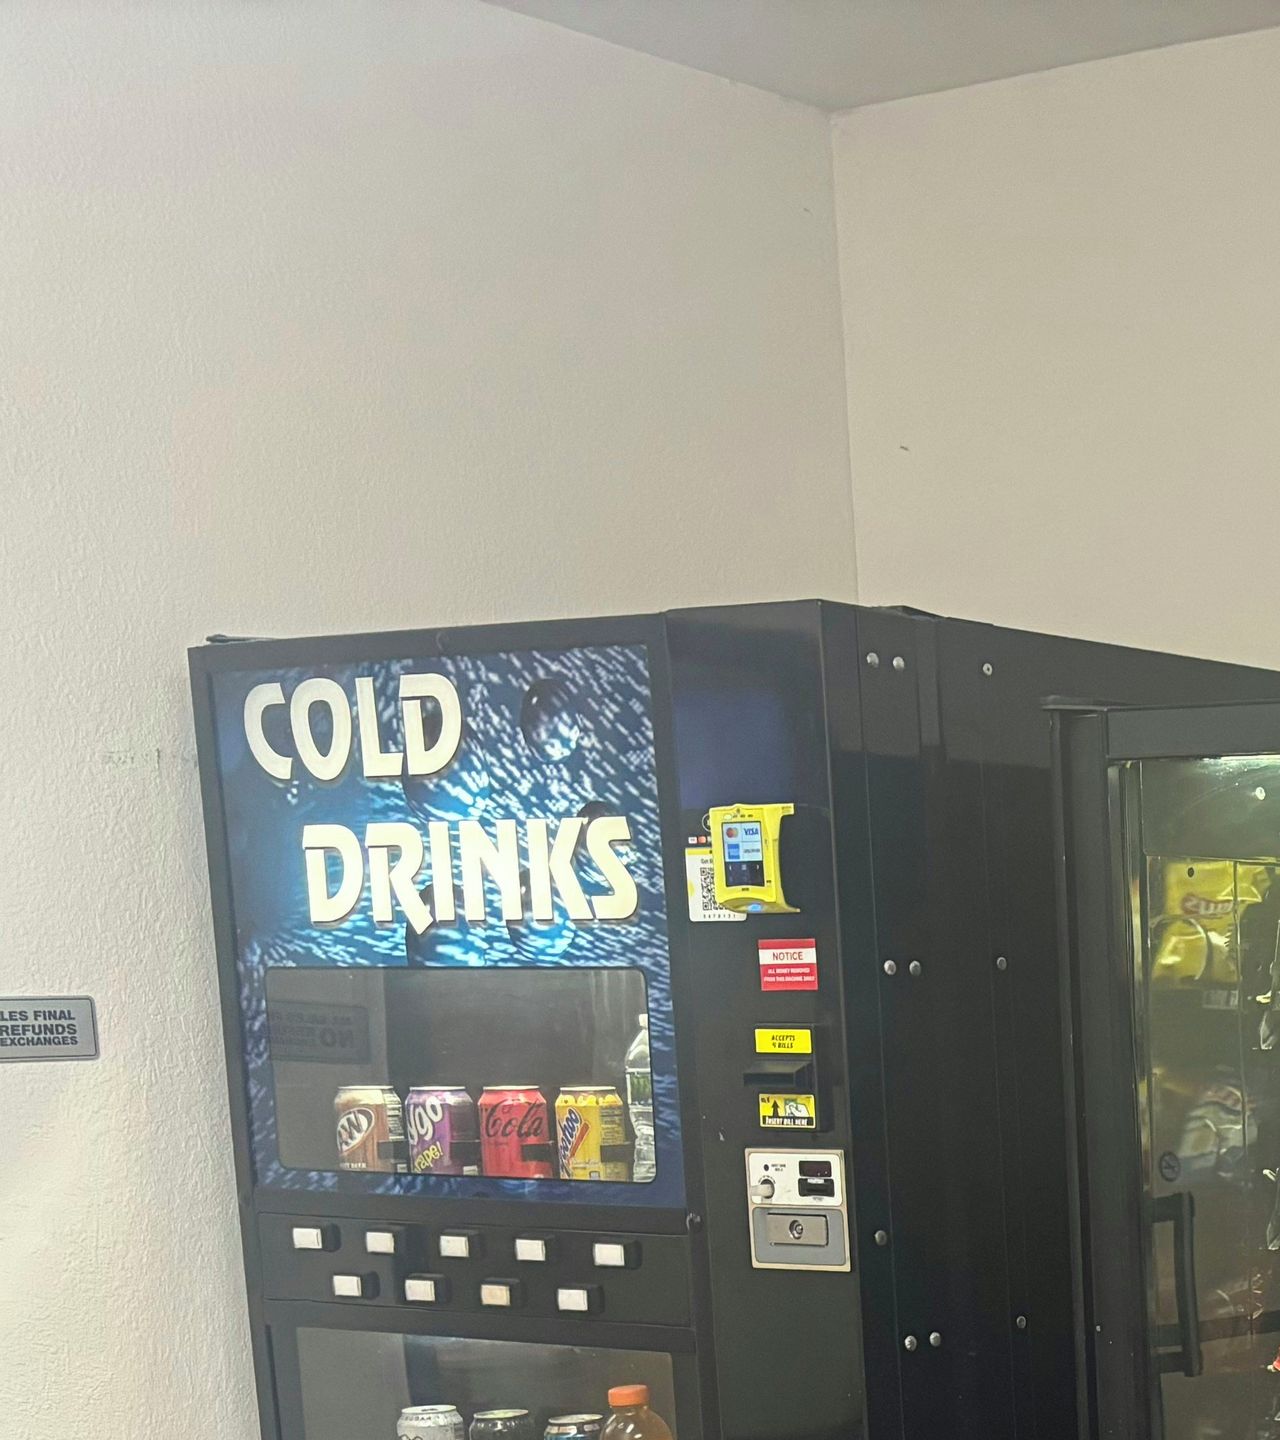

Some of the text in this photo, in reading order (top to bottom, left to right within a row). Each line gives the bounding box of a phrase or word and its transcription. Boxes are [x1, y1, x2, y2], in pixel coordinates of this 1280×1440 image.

[243, 673, 463, 782] COLD
[744, 828, 759, 836] VISA
[302, 816, 639, 935] DRINKS
[773, 951, 804, 961] NOTICE
[33, 1009, 76, 1020] FINAL
[0, 1023, 78, 1036] REFUNDS
[0, 1035, 79, 1047] EXCHANGES
[771, 1034, 796, 1042] ACCEPTS
[766, 1116, 783, 1125] INSERT
